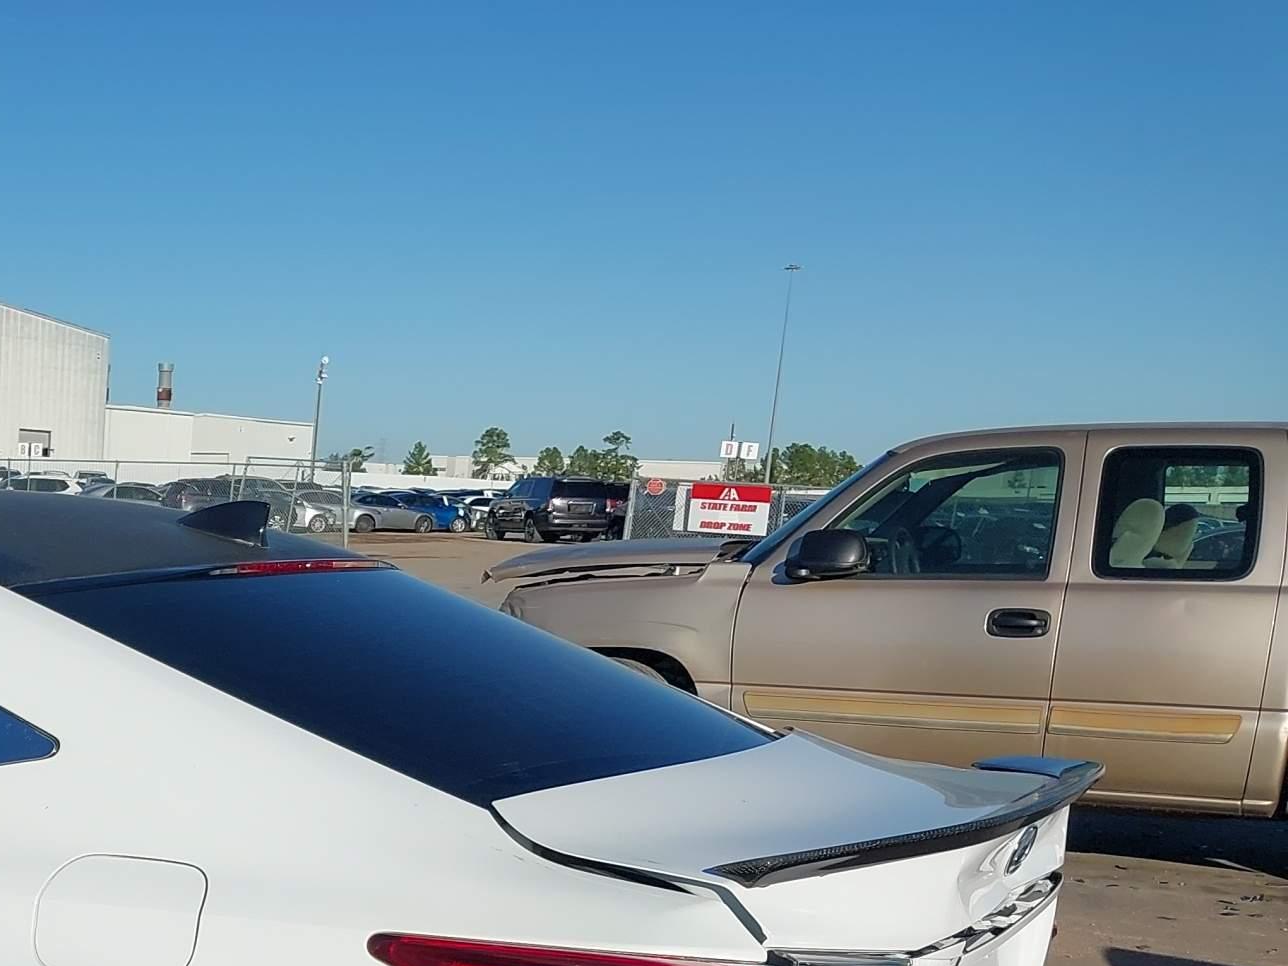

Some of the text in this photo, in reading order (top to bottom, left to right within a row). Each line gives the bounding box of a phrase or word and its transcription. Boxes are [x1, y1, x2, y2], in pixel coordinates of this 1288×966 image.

[33, 444, 40, 456] C
[725, 443, 733, 455] D
[746, 444, 754, 457] F
[700, 501, 757, 513] STATE FARM
[699, 520, 753, 532] DROP ZONE
